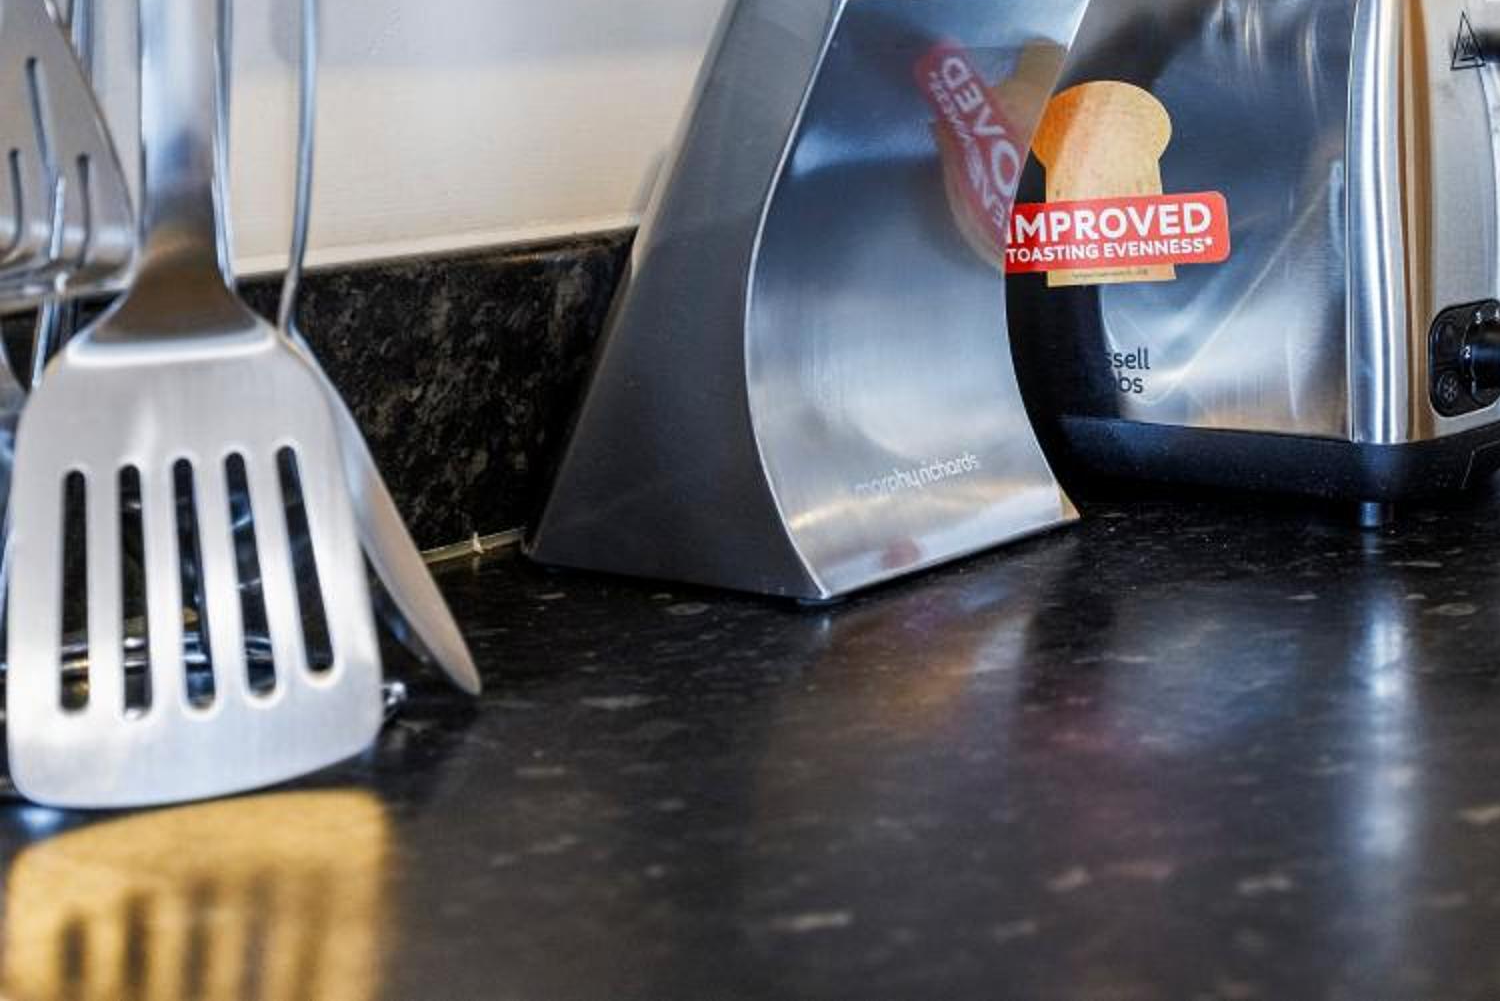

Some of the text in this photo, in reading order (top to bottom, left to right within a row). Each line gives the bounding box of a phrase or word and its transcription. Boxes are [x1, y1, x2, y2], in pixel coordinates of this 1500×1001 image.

[1006, 243, 1100, 264] TOASTING
[1103, 347, 1151, 370] ssell
[1463, 344, 1472, 360] 2
